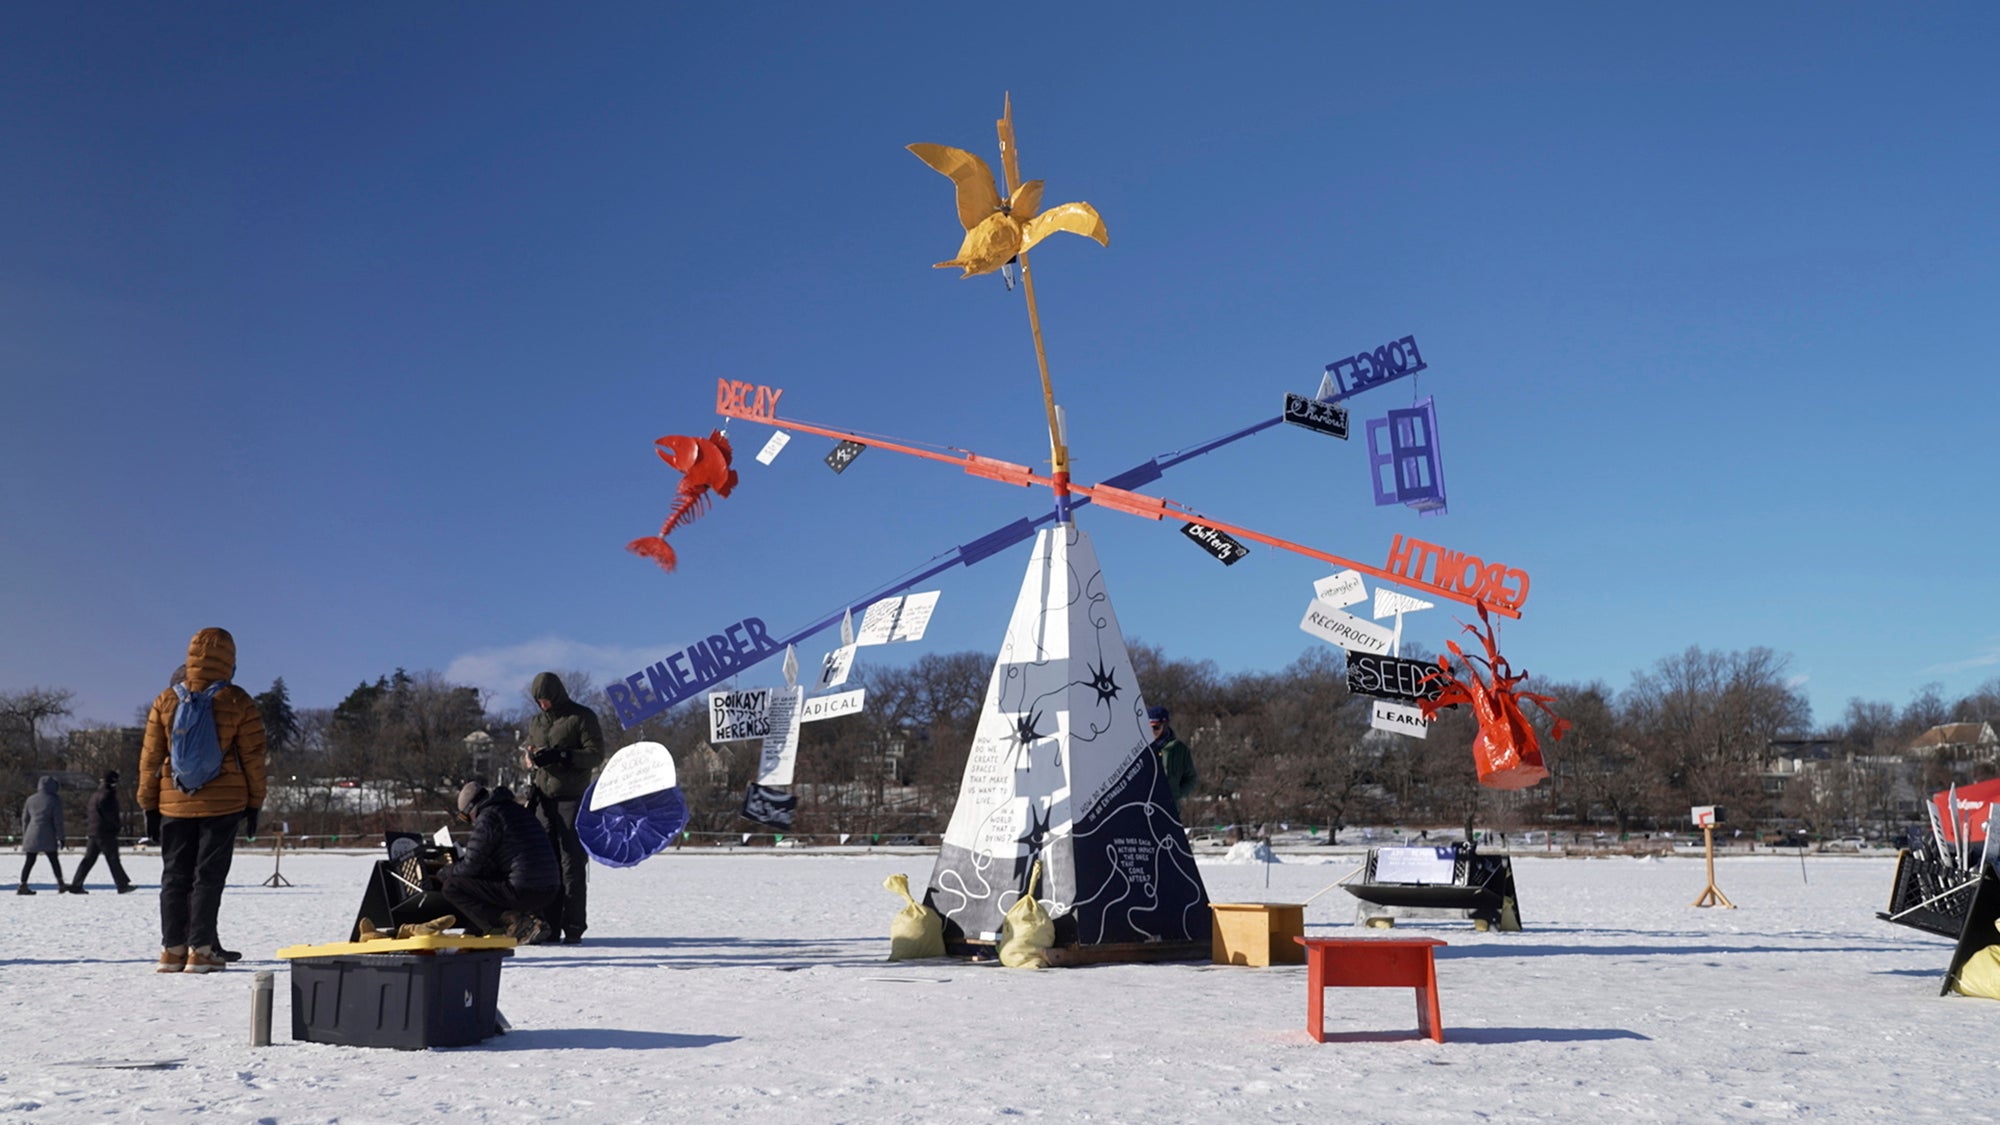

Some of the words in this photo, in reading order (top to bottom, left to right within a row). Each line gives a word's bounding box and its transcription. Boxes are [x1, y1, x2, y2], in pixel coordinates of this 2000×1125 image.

[716, 377, 783, 421] DECAY
[1188, 524, 1232, 559] Butterfly
[1308, 611, 1386, 651] RECIPROCITY
[605, 617, 779, 729] REMEMBER
[714, 691, 766, 711] DOIKAYT
[804, 697, 858, 716] ADICAL
[716, 717, 770, 739] HERENESS
[1376, 710, 1427, 728] LEARN
